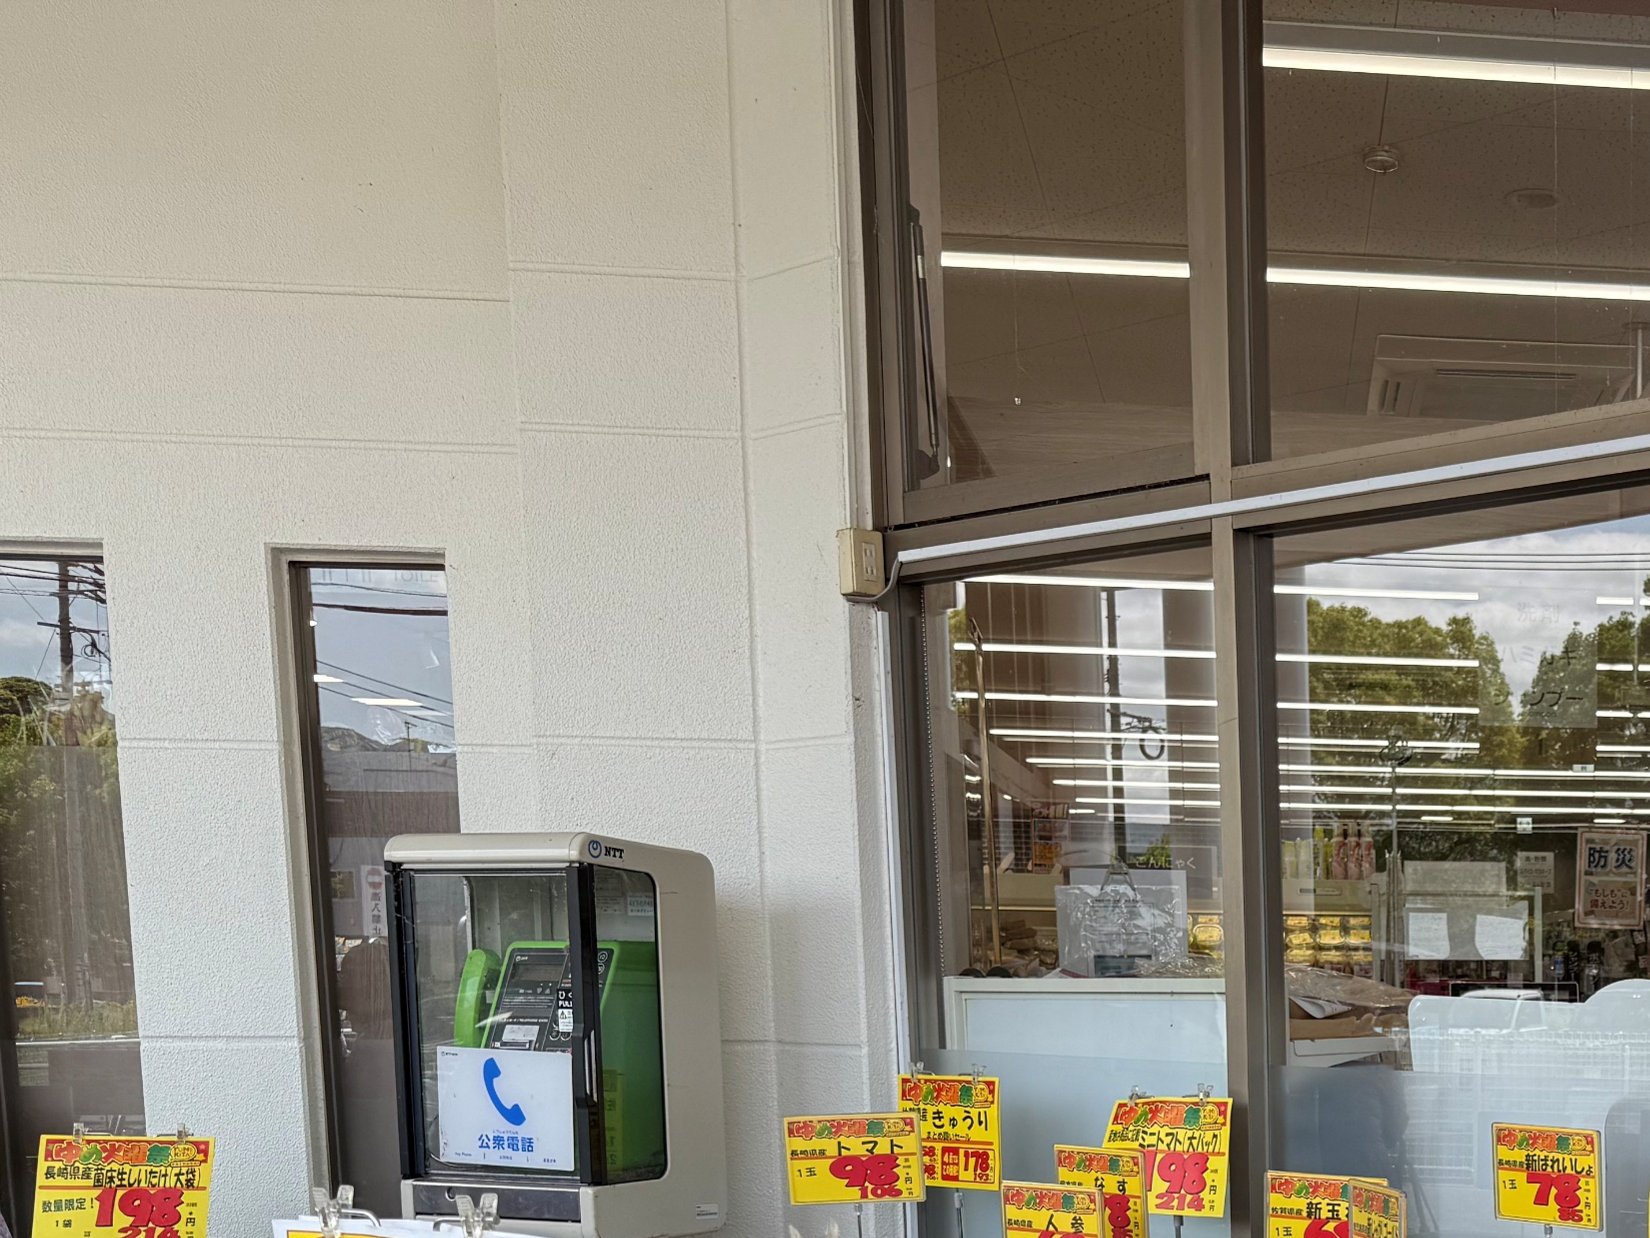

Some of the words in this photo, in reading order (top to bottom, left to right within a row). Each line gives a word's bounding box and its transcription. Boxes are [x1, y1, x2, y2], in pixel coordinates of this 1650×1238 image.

[604, 846, 625, 859] NTT
[1134, 855, 1197, 871] こんにゃく
[1587, 845, 1636, 870] 防災
[931, 1109, 989, 1132] きゅうり
[478, 1134, 534, 1153] 公衆電話
[837, 1138, 904, 1157] トマト
[1138, 1129, 1222, 1153] ミニトマト(大パック)
[796, 1166, 817, 1178] 1玉
[829, 1154, 901, 1188] 98
[963, 1150, 990, 1172] 178
[1525, 1153, 1594, 1176] 新ばれいしょ
[44, 1165, 93, 1181] 長崎県産
[92, 1165, 201, 1189] 菌床生しいたけ(大袋)
[1093, 1176, 1128, 1195] なす
[1502, 1179, 1517, 1190] 1玉
[1526, 1171, 1582, 1208] 78
[41, 1197, 94, 1214] 数量限定!
[95, 1187, 185, 1228] 198
[185, 1217, 196, 1228] 円
[1104, 1194, 1131, 1229] 8
[1154, 1192, 1206, 1212] 214
[1305, 1200, 1350, 1221] 新玉
[55, 1218, 73, 1229] 1袋
[1045, 1213, 1085, 1234] 人参
[1275, 1226, 1293, 1237] 1玉
